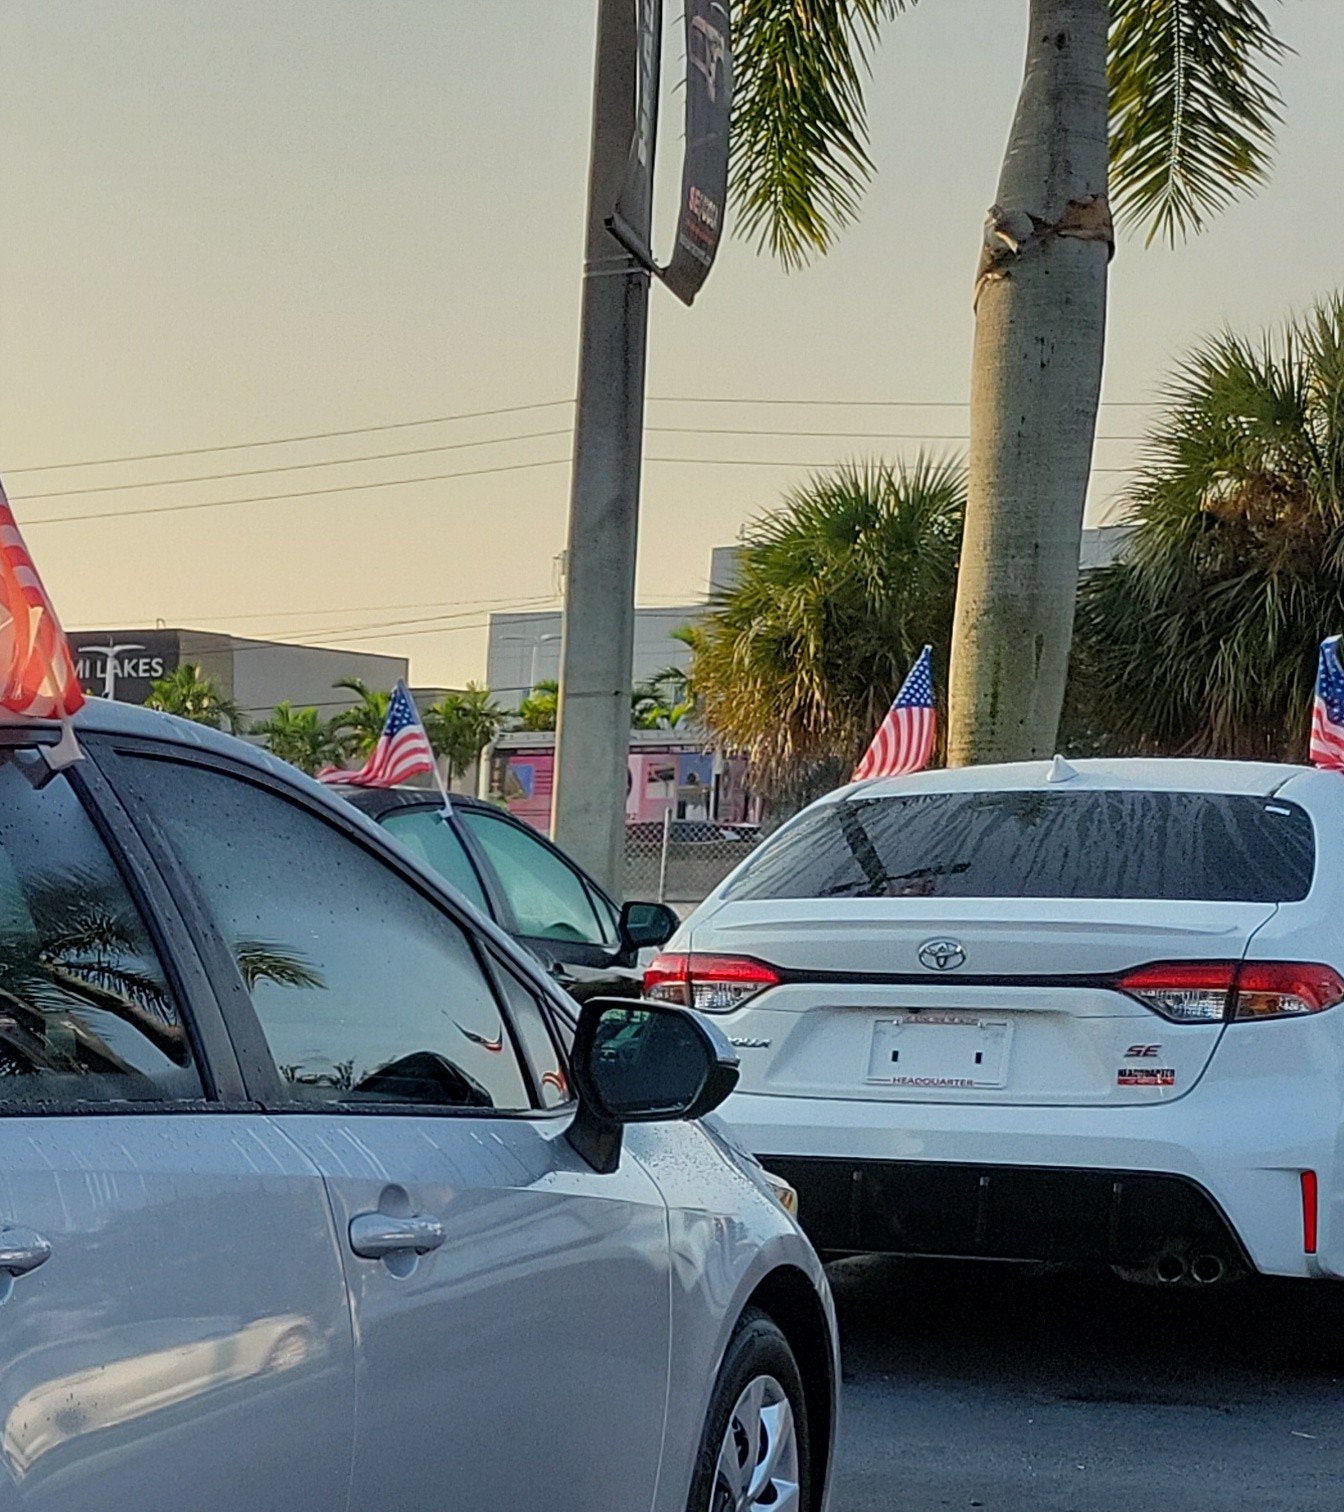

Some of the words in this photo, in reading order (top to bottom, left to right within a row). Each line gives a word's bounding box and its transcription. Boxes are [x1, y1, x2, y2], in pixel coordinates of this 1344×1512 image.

[96, 657, 164, 678] LAKES
[1123, 1044, 1163, 1058] SE
[892, 1077, 974, 1087] HEADQUARTER
